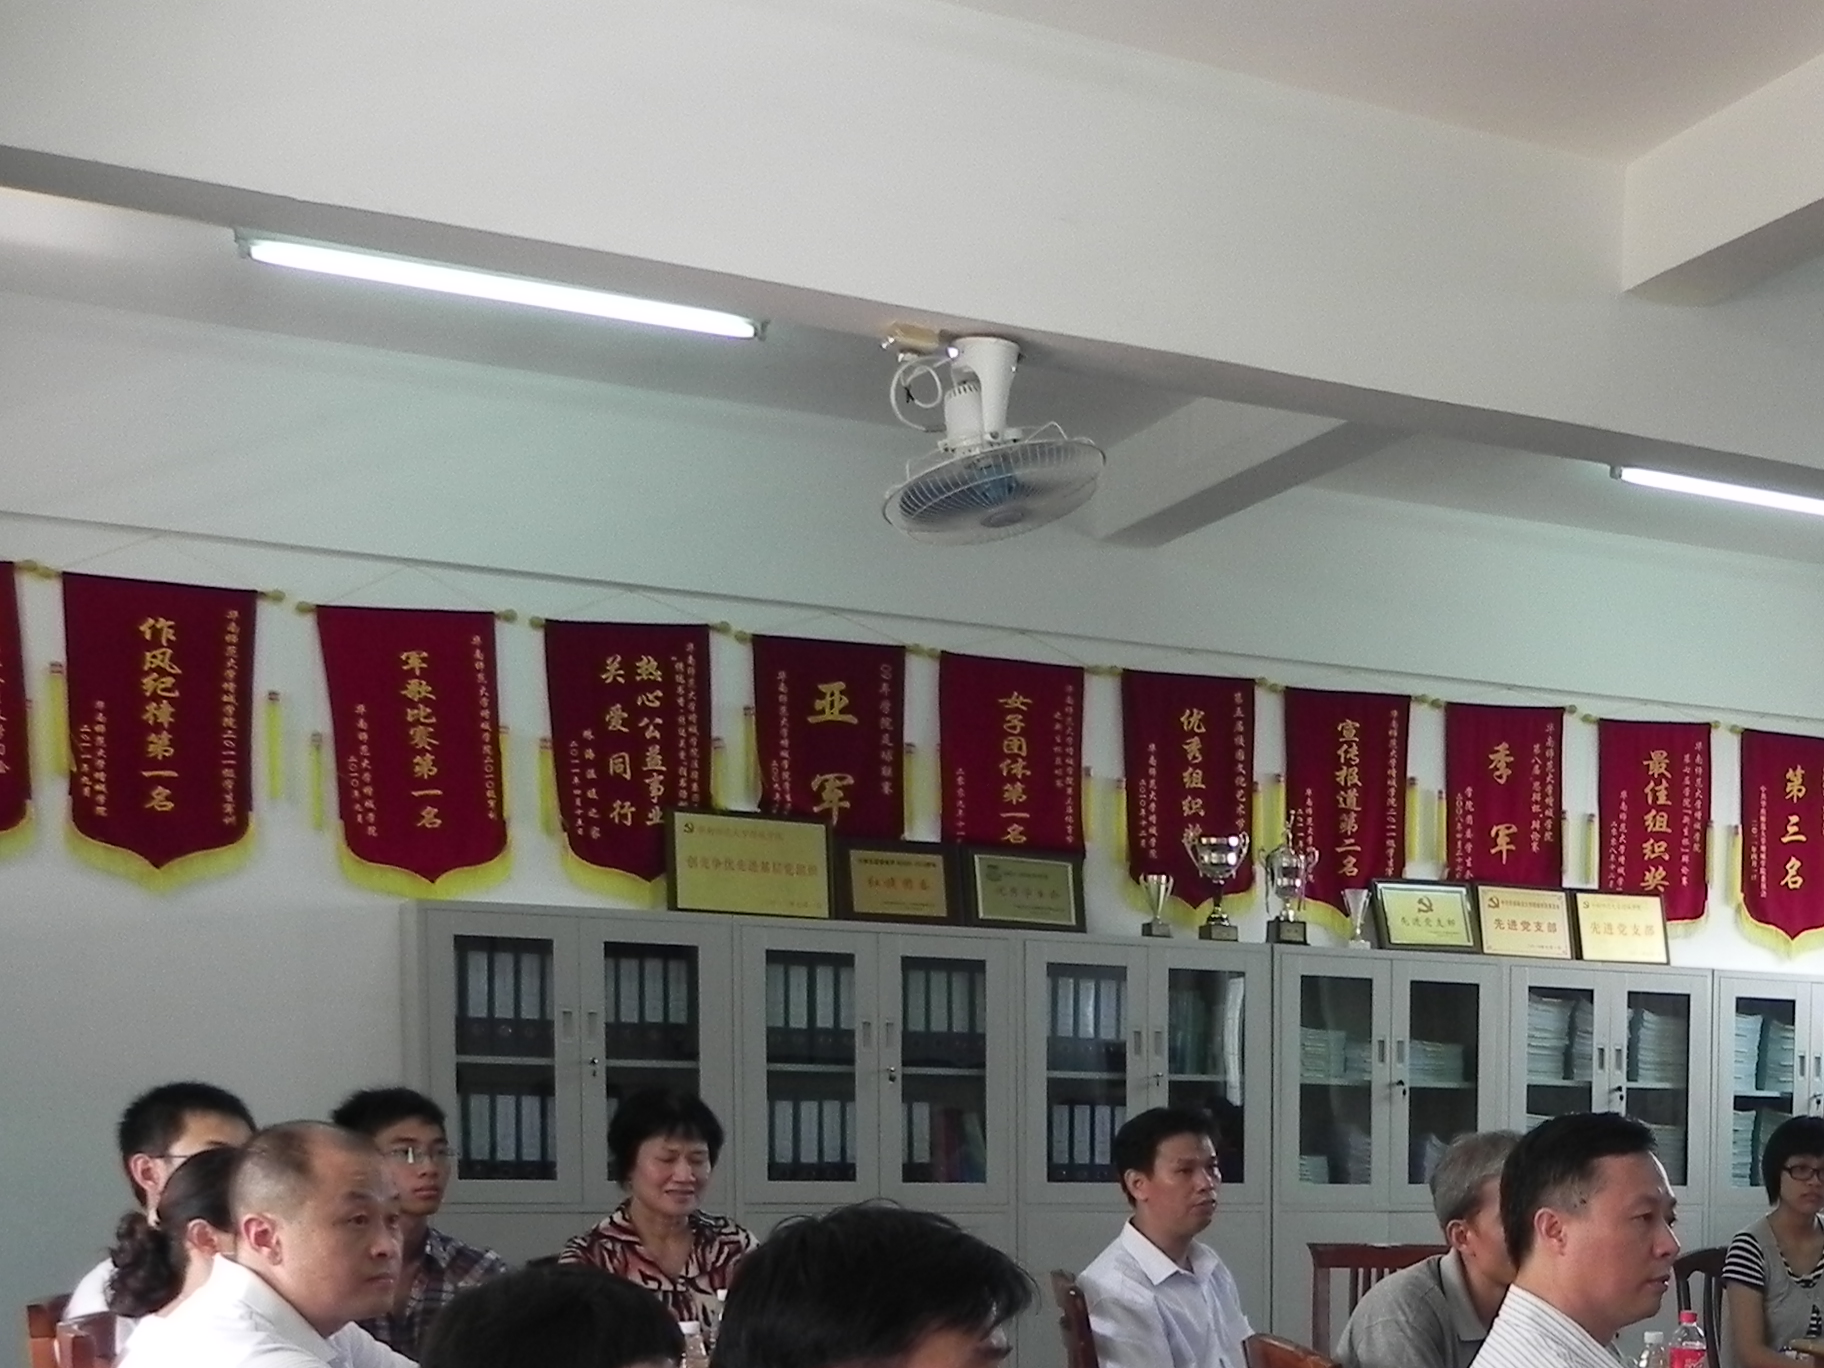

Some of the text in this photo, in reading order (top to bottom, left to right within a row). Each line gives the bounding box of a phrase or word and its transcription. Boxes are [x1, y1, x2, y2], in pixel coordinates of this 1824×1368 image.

[139, 617, 182, 811] 作风纪律第一名
[400, 651, 442, 828] 军歌比赛第一名
[600, 654, 636, 827] 关爱同行
[634, 655, 667, 826] 热心公益事业
[804, 681, 858, 832] 亚军
[999, 691, 1032, 843] 女子团体第一名
[1335, 719, 1362, 876] 宣传报道第二名
[1489, 742, 1517, 864] 季军
[1640, 750, 1672, 892] 最佳组织奖
[1781, 765, 1806, 889] 第三名
[1494, 918, 1558, 934] 先进党支部
[1590, 921, 1655, 937] 先进党支部
